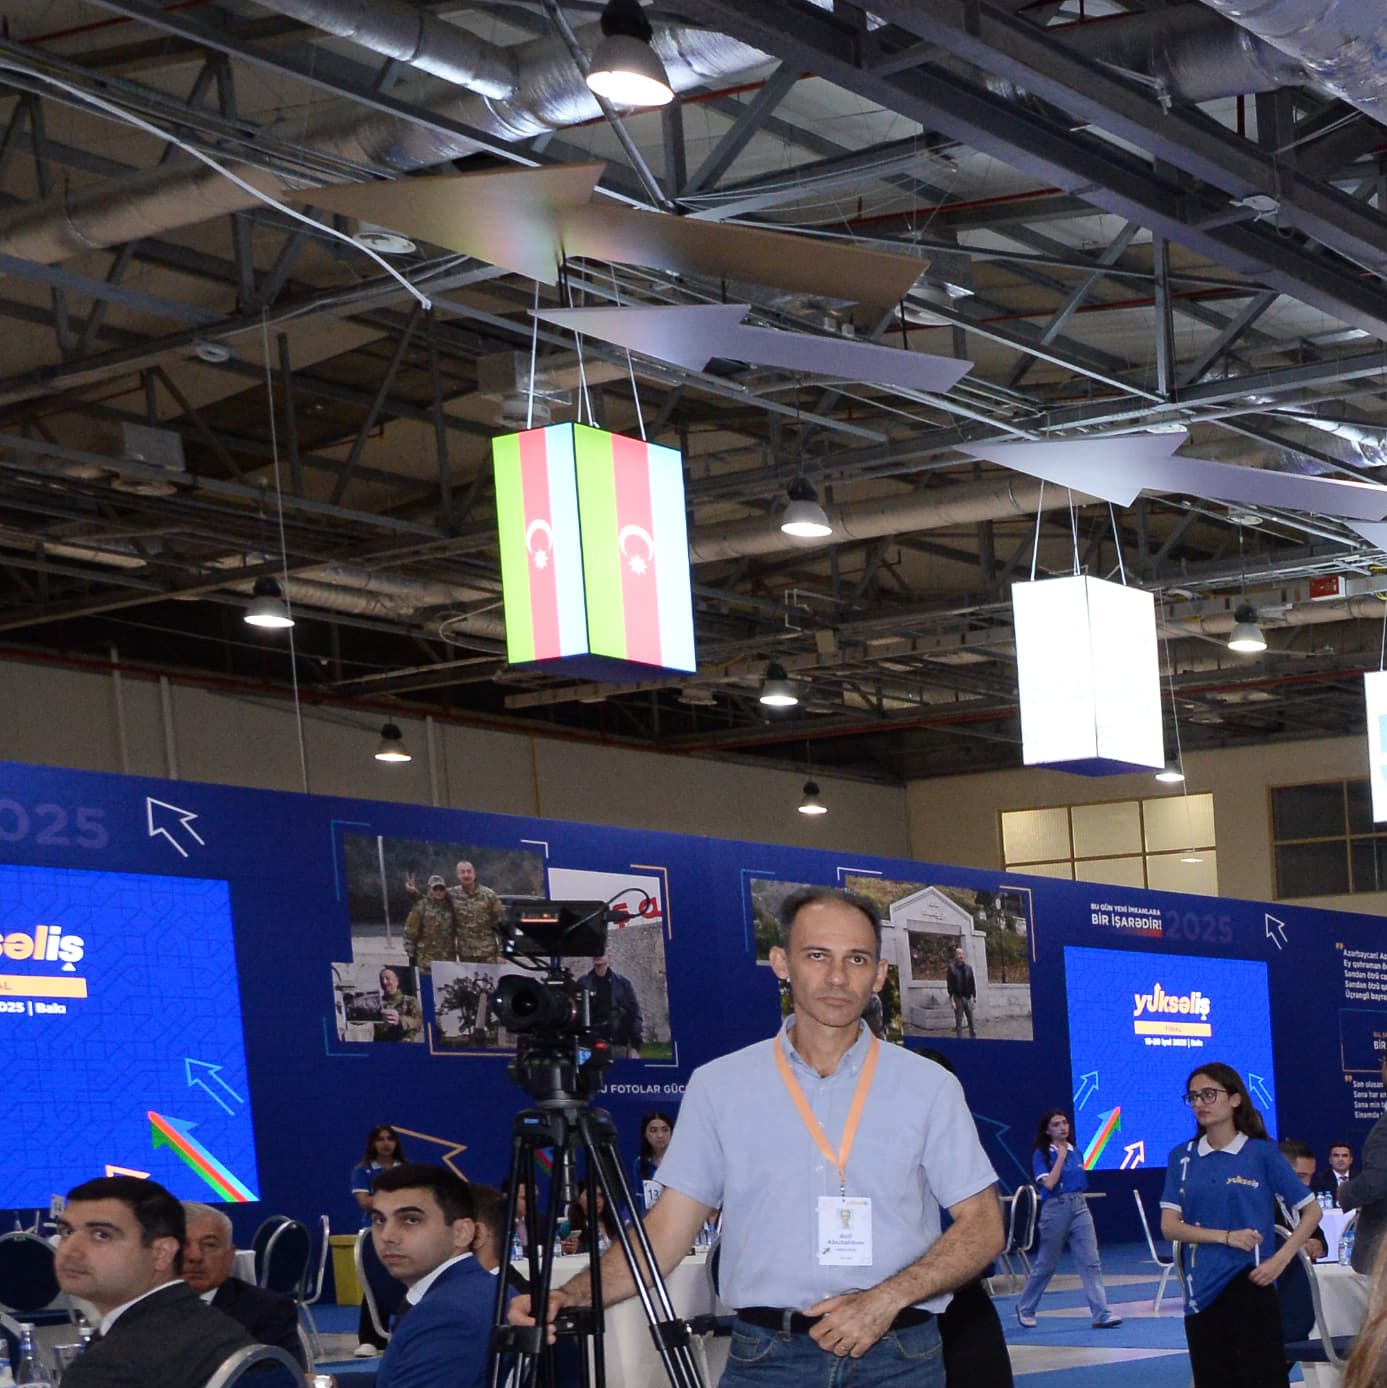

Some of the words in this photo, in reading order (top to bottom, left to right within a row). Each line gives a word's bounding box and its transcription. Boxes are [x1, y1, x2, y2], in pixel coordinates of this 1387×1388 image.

[1091, 912, 1109, 925] BİR
[1112, 914, 1162, 931] İŞARƏDİR!
[1165, 910, 1233, 944] 2025
[0, 925, 84, 971] əliş
[1133, 982, 1210, 1020] yüksəliş
[610, 1084, 660, 1094] FOTOLAR
[664, 1082, 687, 1094] GÜC
